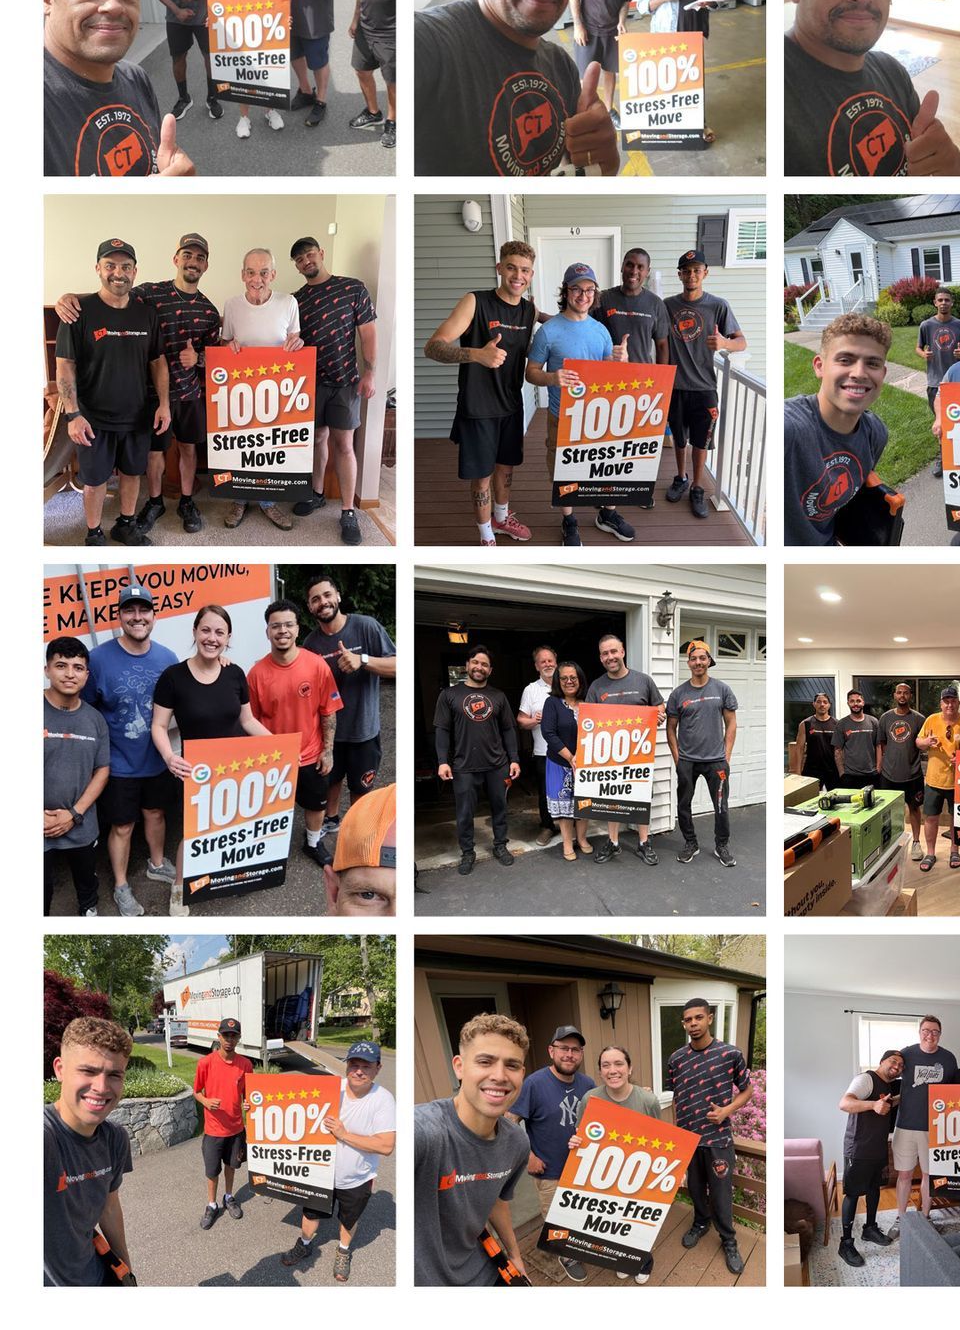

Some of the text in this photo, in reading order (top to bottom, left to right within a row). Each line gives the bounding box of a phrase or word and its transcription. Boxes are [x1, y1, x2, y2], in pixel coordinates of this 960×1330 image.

[530, 80, 549, 92] 1972
[846, 98, 884, 119] EST. 1972
[95, 111, 132, 130] EST. 1972
[523, 114, 543, 134] CT
[866, 132, 886, 157] CT
[114, 147, 132, 170] CT
[571, 227, 581, 235] 40
[212, 376, 309, 428] 100%
[566, 393, 663, 442] 100%
[212, 428, 309, 451] Stress-Free
[241, 450, 286, 468] Move
[562, 441, 658, 464] Stress-Free
[590, 462, 633, 478] Move
[135, 570, 175, 591] YOU
[581, 728, 651, 764] 100%
[579, 767, 650, 783] Stress-Free
[599, 783, 632, 796] Move
[573, 1143, 681, 1194] 100%
[559, 1190, 662, 1221] Stress-Free
[584, 1214, 631, 1237] Move
